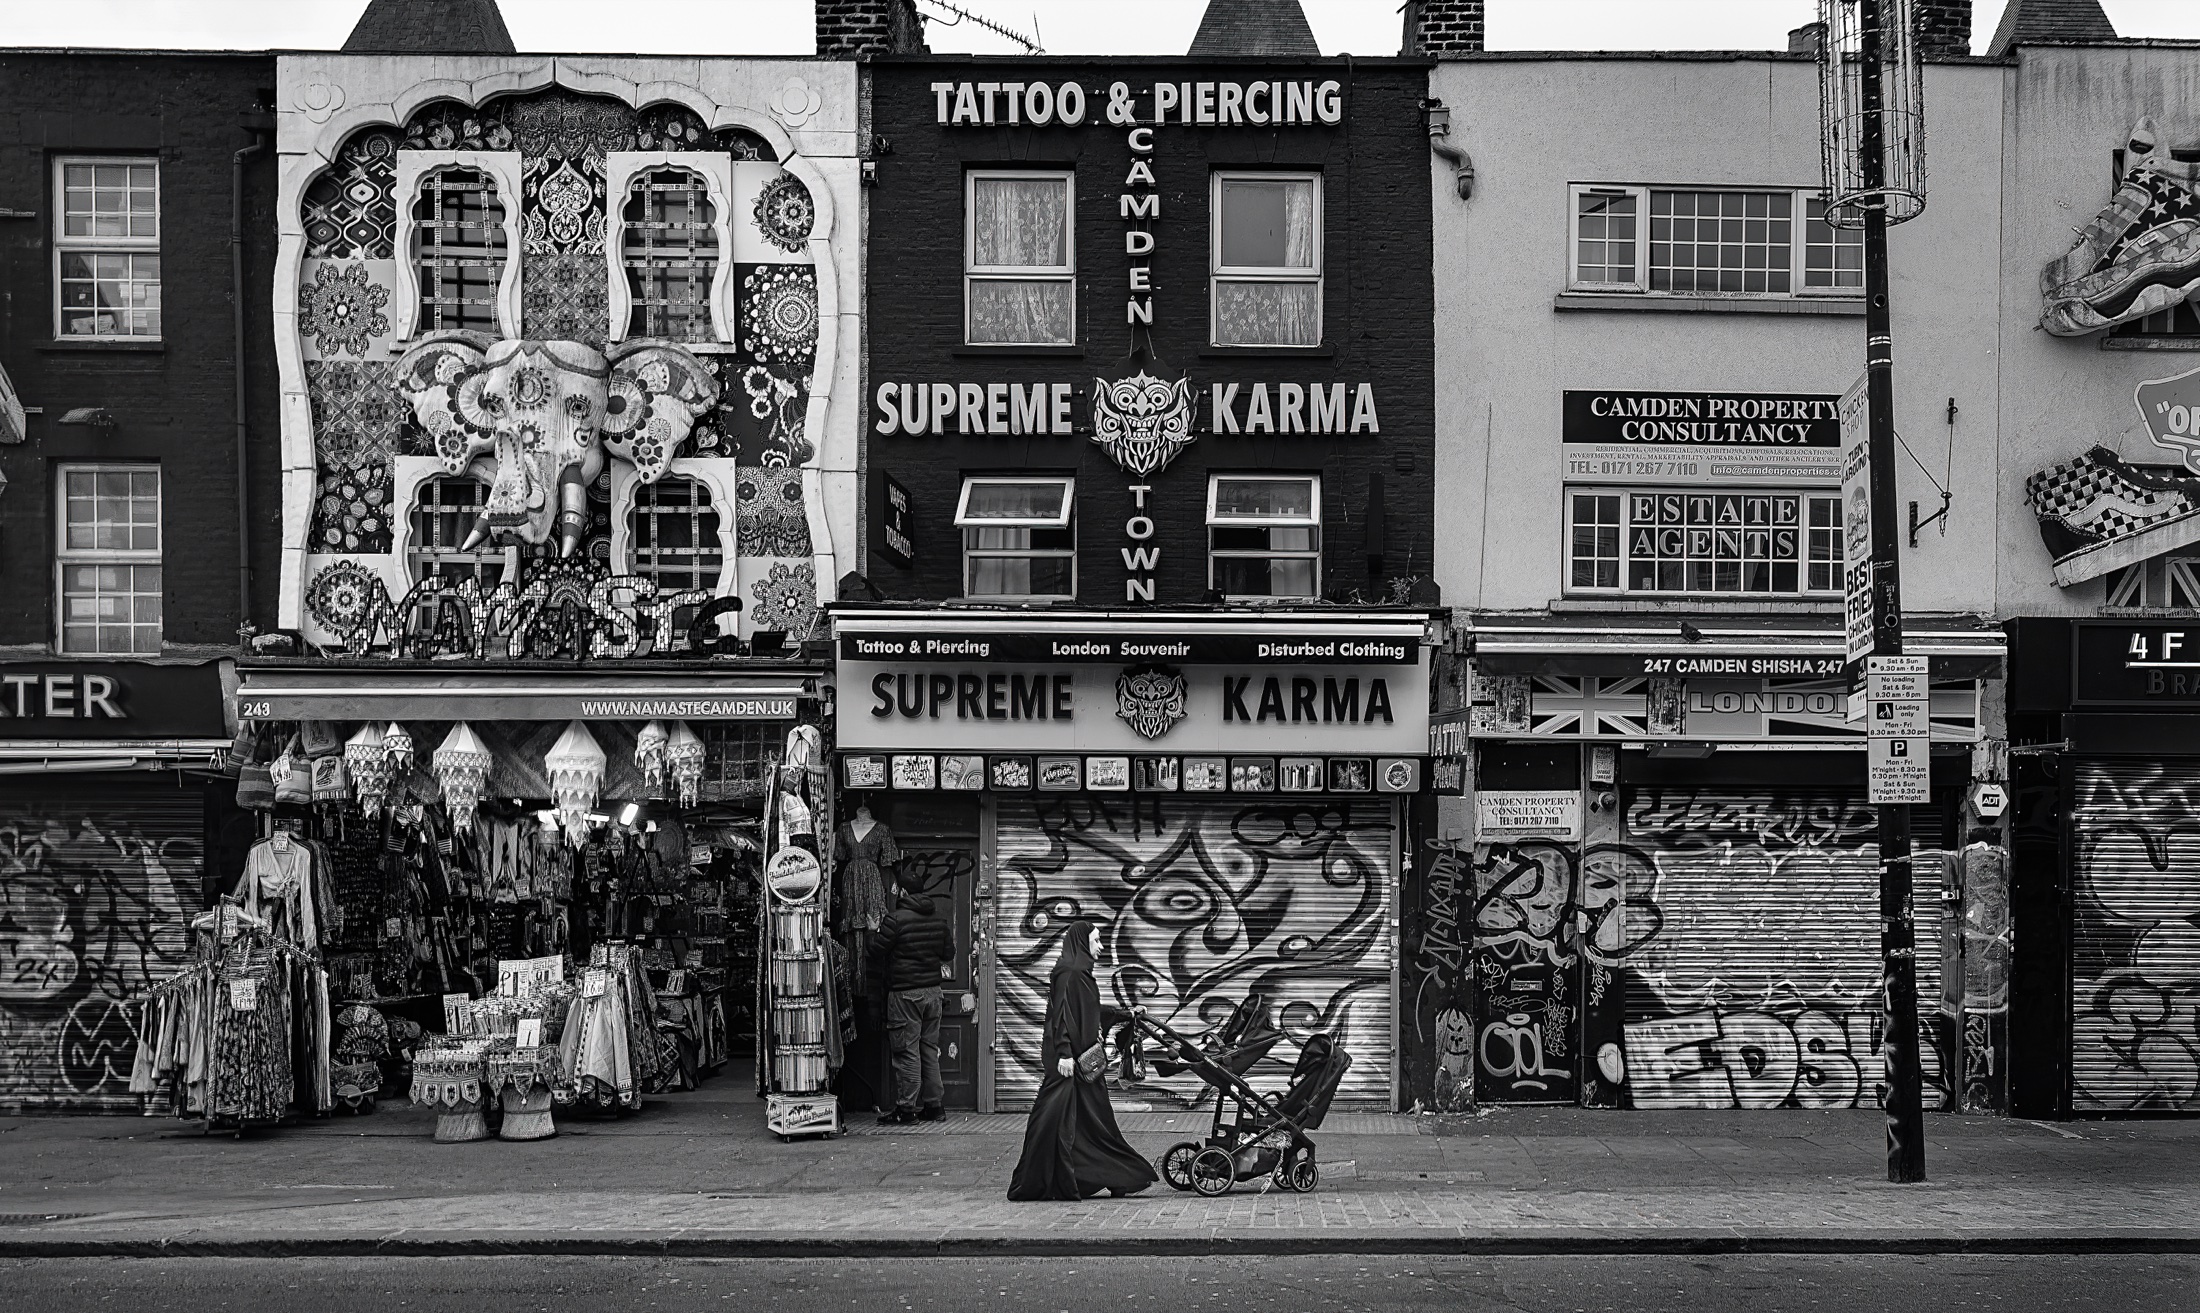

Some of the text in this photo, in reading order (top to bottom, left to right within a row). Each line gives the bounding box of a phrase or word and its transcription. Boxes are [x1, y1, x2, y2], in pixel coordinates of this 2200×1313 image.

[931, 80, 1342, 126] TATTOO & PIERCING
[1120, 127, 1160, 327] CAMDEN
[875, 381, 1380, 436] SUPREME KARMA
[1590, 397, 1840, 421] CAMDEN PROPERTY
[1622, 421, 1812, 443] CONSULTANCY
[1569, 460, 1698, 476] TEL: 0171 267 7110
[1631, 495, 1797, 525] ESTATE
[1121, 485, 1160, 601] TOWN
[1631, 528, 1794, 557] AGENTS
[1847, 556, 1874, 598] BEST
[856, 639, 1405, 659] Tattoo & Piercing London Souvenir Disturbed Clothing
[1644, 659, 1671, 673] 247
[1675, 659, 1747, 673] CAMDEN
[1751, 659, 1814, 674] SHISHA
[1817, 660, 1844, 675] 247
[0, 674, 127, 718] TER
[871, 672, 1394, 724] SUPREME KARMA
[243, 701, 271, 718] 243
[581, 699, 794, 718] WWW.NAMASTECAMDEN.UK
[1430, 721, 1466, 757] TATTOO
[1894, 742, 1905, 755] P
[1480, 797, 1577, 806] CAMDEN PROPERTY
[1492, 807, 1565, 816] CONSULTANCY
[1982, 796, 2000, 805] ADT
[1500, 816, 1513, 826] TEL:
